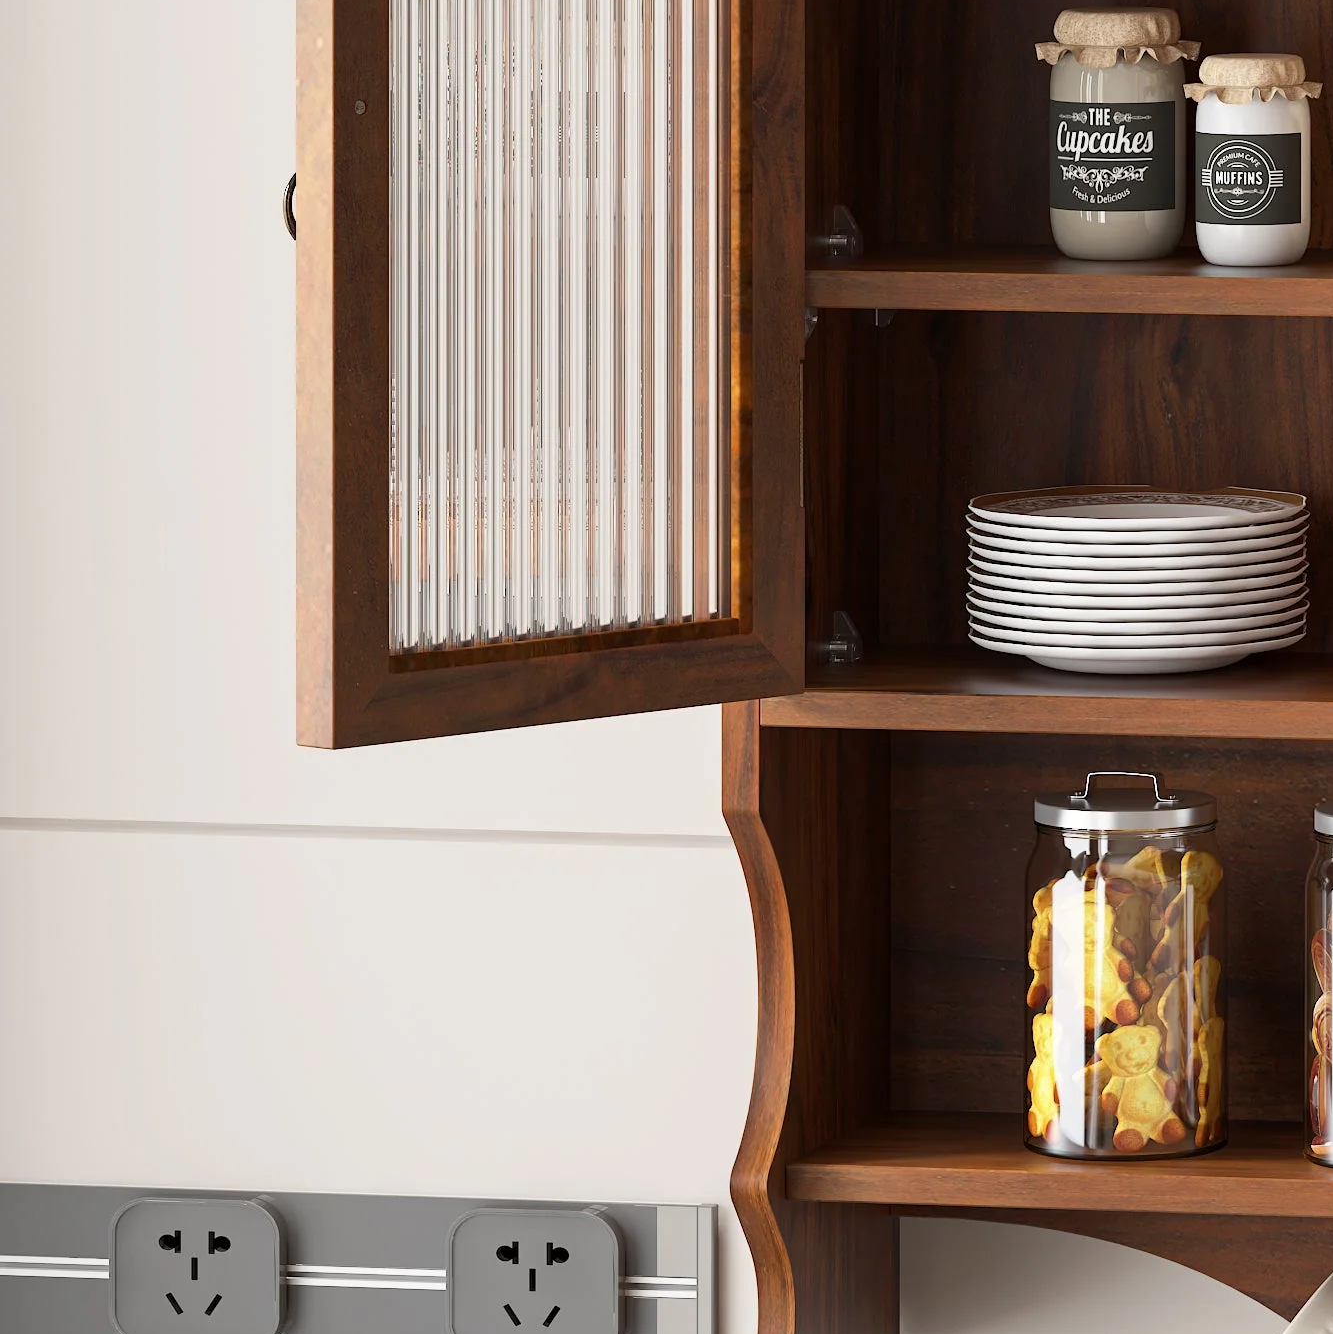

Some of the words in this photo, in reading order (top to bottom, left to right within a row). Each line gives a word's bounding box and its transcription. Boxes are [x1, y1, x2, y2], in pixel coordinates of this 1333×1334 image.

[1088, 108, 1111, 126] THE
[1057, 120, 1154, 162] Cupcakes
[1217, 152, 1245, 168] PREMIUM
[1244, 154, 1261, 167] CAFE
[1215, 170, 1263, 185] MUFFINS
[1072, 186, 1089, 203] Fresh
[1089, 195, 1096, 204] &
[1097, 188, 1131, 204] Delicious
